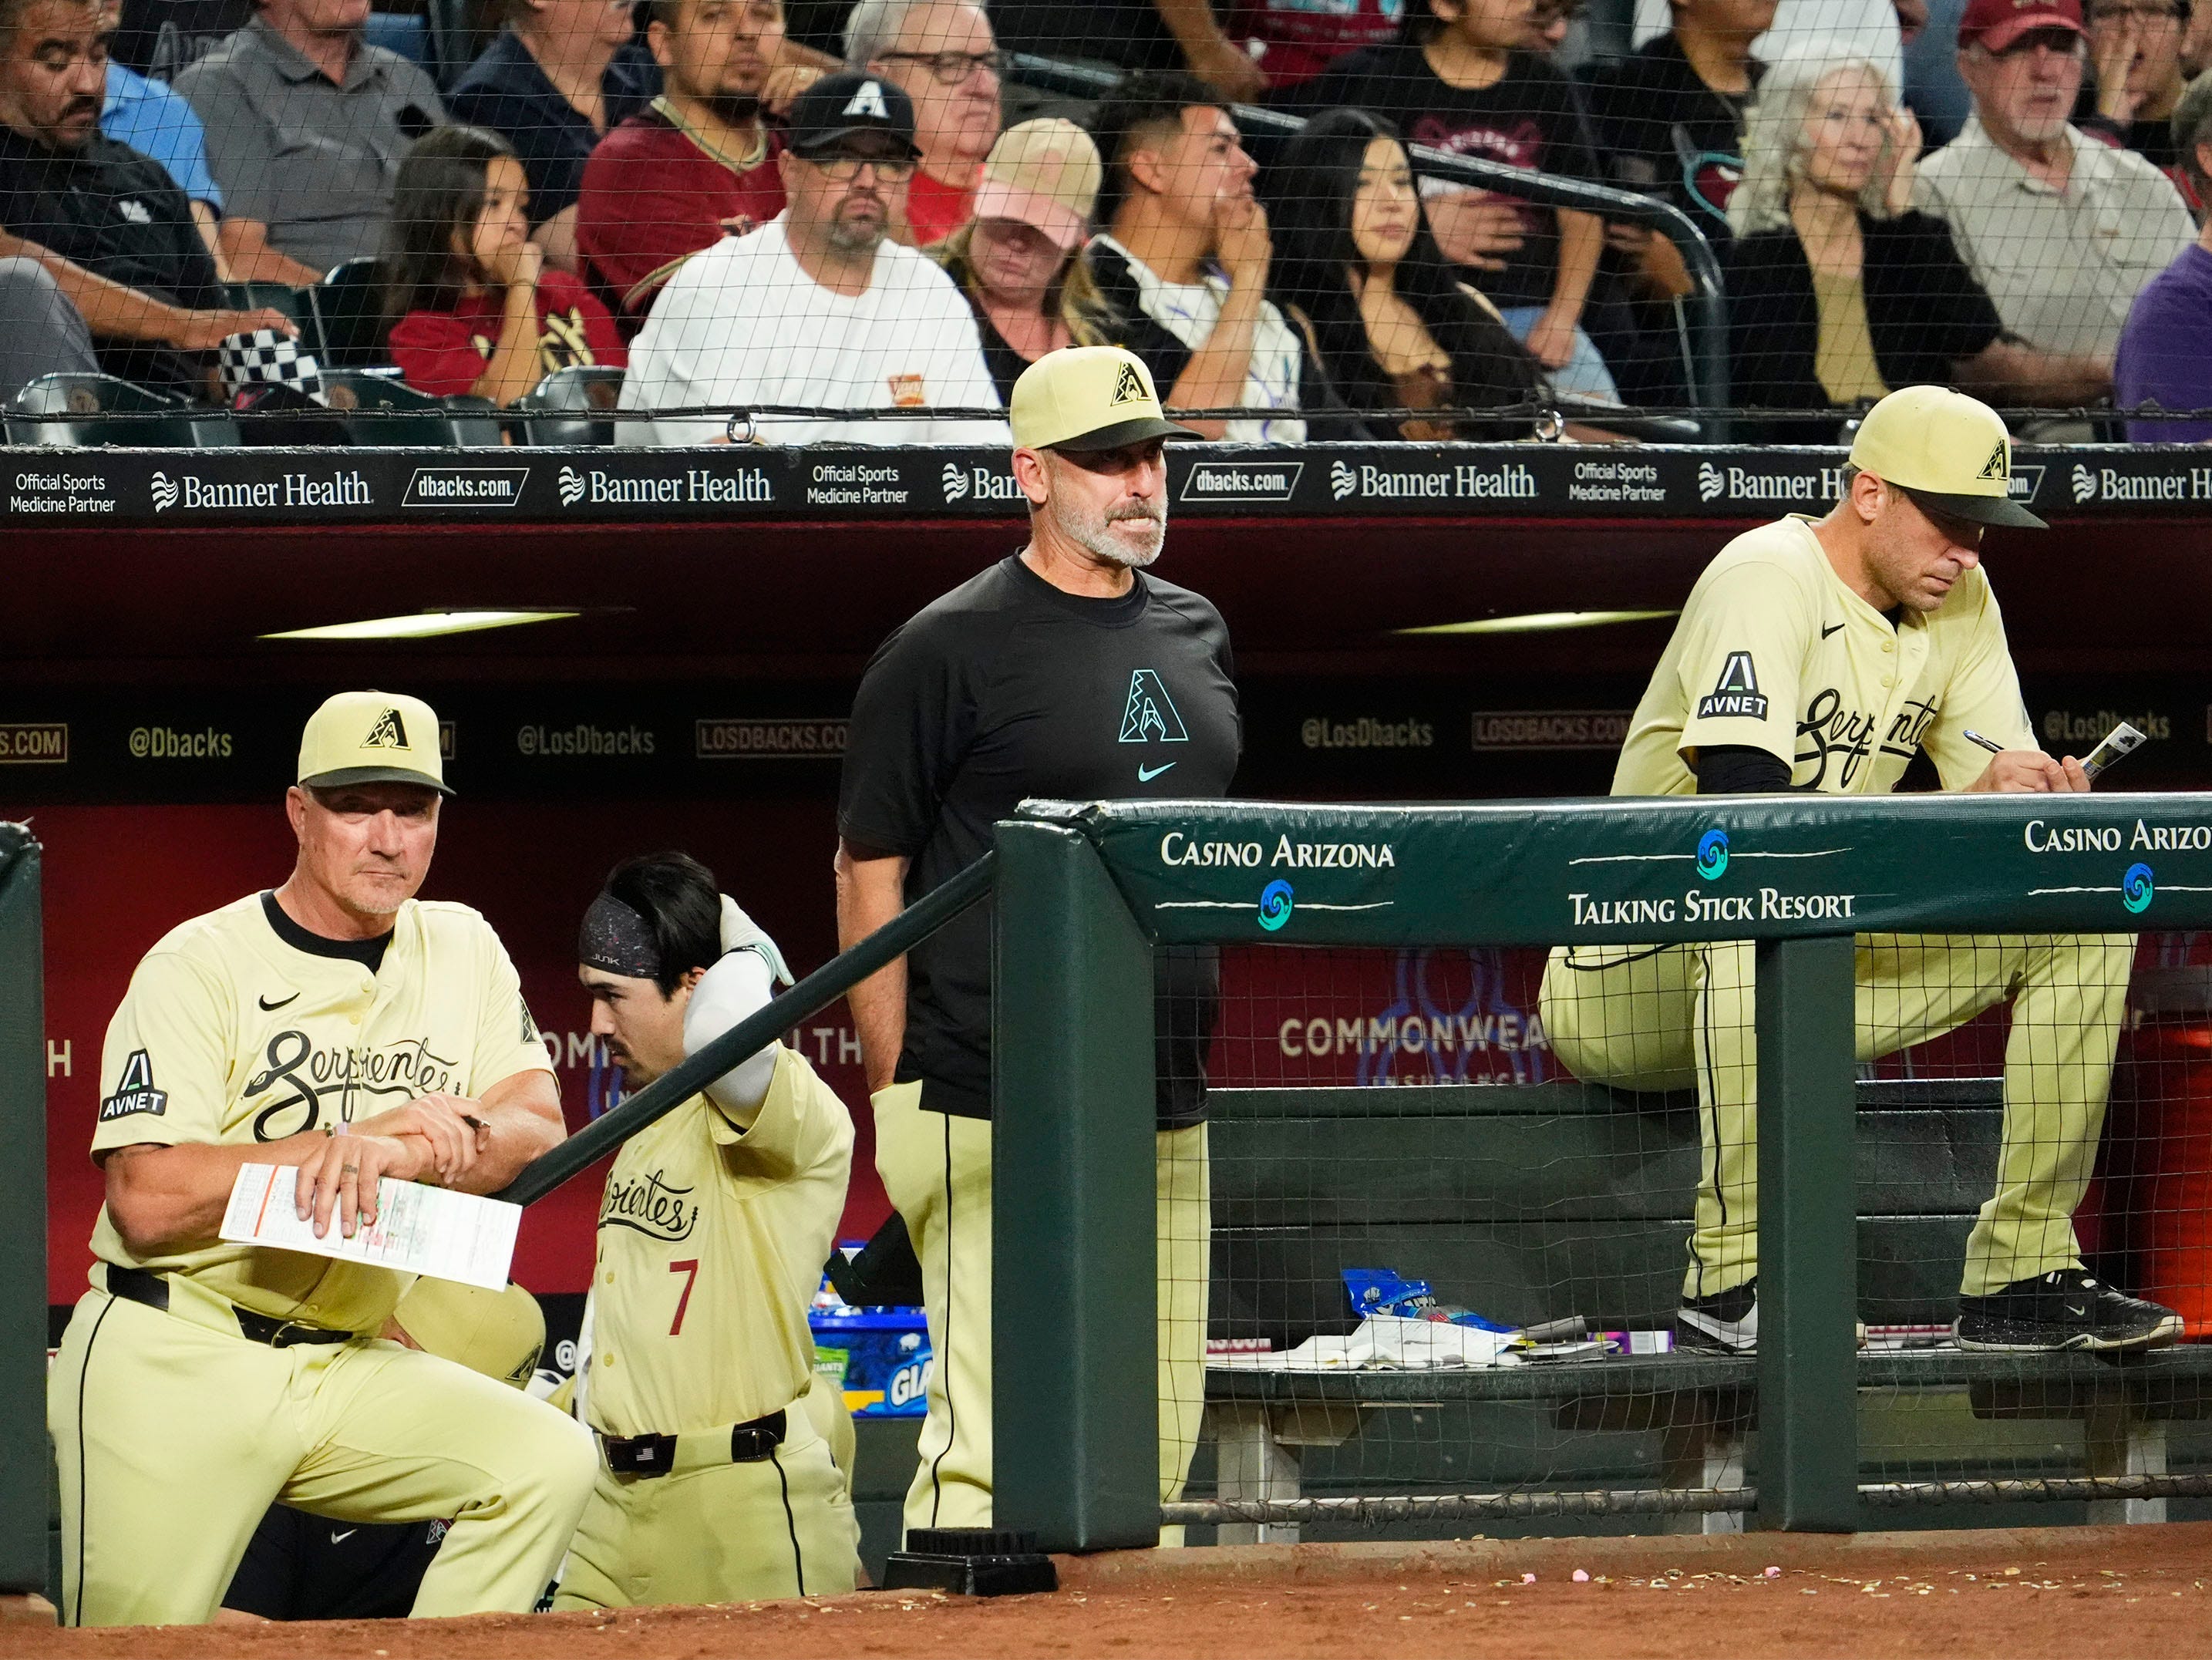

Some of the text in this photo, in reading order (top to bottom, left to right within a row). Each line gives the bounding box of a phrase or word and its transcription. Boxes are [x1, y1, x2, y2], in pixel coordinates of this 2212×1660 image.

[15, 473, 106, 493] Official Sports
[417, 473, 512, 497] dbacks.com
[591, 468, 771, 502] Banner Health
[813, 465, 899, 485] Official Sports
[973, 469, 1028, 500] Ban
[1197, 467, 1285, 492] dbacks.com
[1361, 464, 1535, 498] Banner Health
[1574, 463, 1657, 482] Official Sports
[1728, 467, 1817, 500] Banner
[2101, 468, 2187, 501] Banner
[10, 495, 116, 513] Medicine Partner
[183, 470, 371, 508] Banner Health
[807, 487, 908, 504] Medicine Partner
[1569, 484, 1665, 502] Medicine Partner
[1701, 696, 1767, 716] AVNET
[129, 726, 232, 758] @Dbacks
[517, 725, 655, 756] @LosDbacks
[1301, 718, 1433, 749] @LosDbacks
[2130, 818, 2212, 852] ARIZO
[592, 954, 620, 967] JUNK
[1280, 1015, 1549, 1056] COMMONWEA
[103, 1092, 163, 1117] AVNET
[669, 1258, 698, 1335] 7
[890, 1359, 934, 1407] GIA
